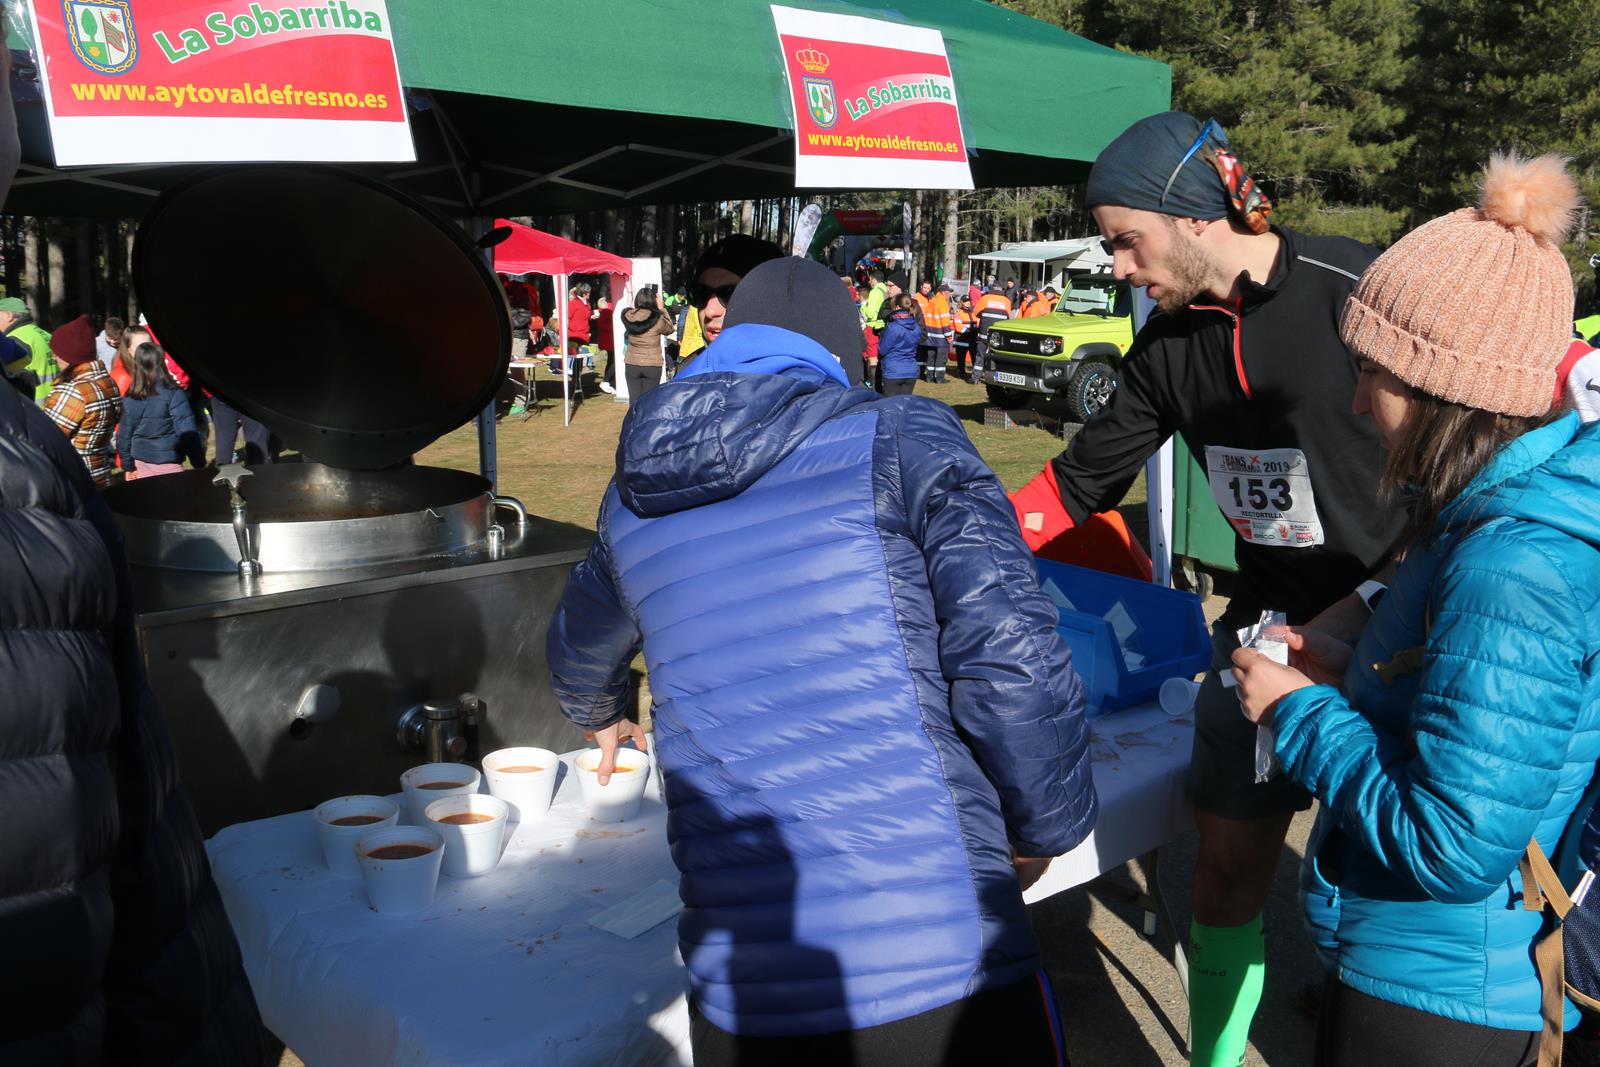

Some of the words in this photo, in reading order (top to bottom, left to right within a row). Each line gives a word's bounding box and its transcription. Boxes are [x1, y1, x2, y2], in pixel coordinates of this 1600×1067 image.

[153, 26, 208, 64] La
[205, 0, 383, 46] Sobarriba
[71, 81, 388, 109] www.aytovaldefresno.es
[844, 98, 870, 121] La
[868, 79, 951, 109] Sobarriba
[808, 132, 959, 153] www.aytovaldefresno.es
[1263, 461, 1290, 473] 2019
[1228, 476, 1293, 512] 153
